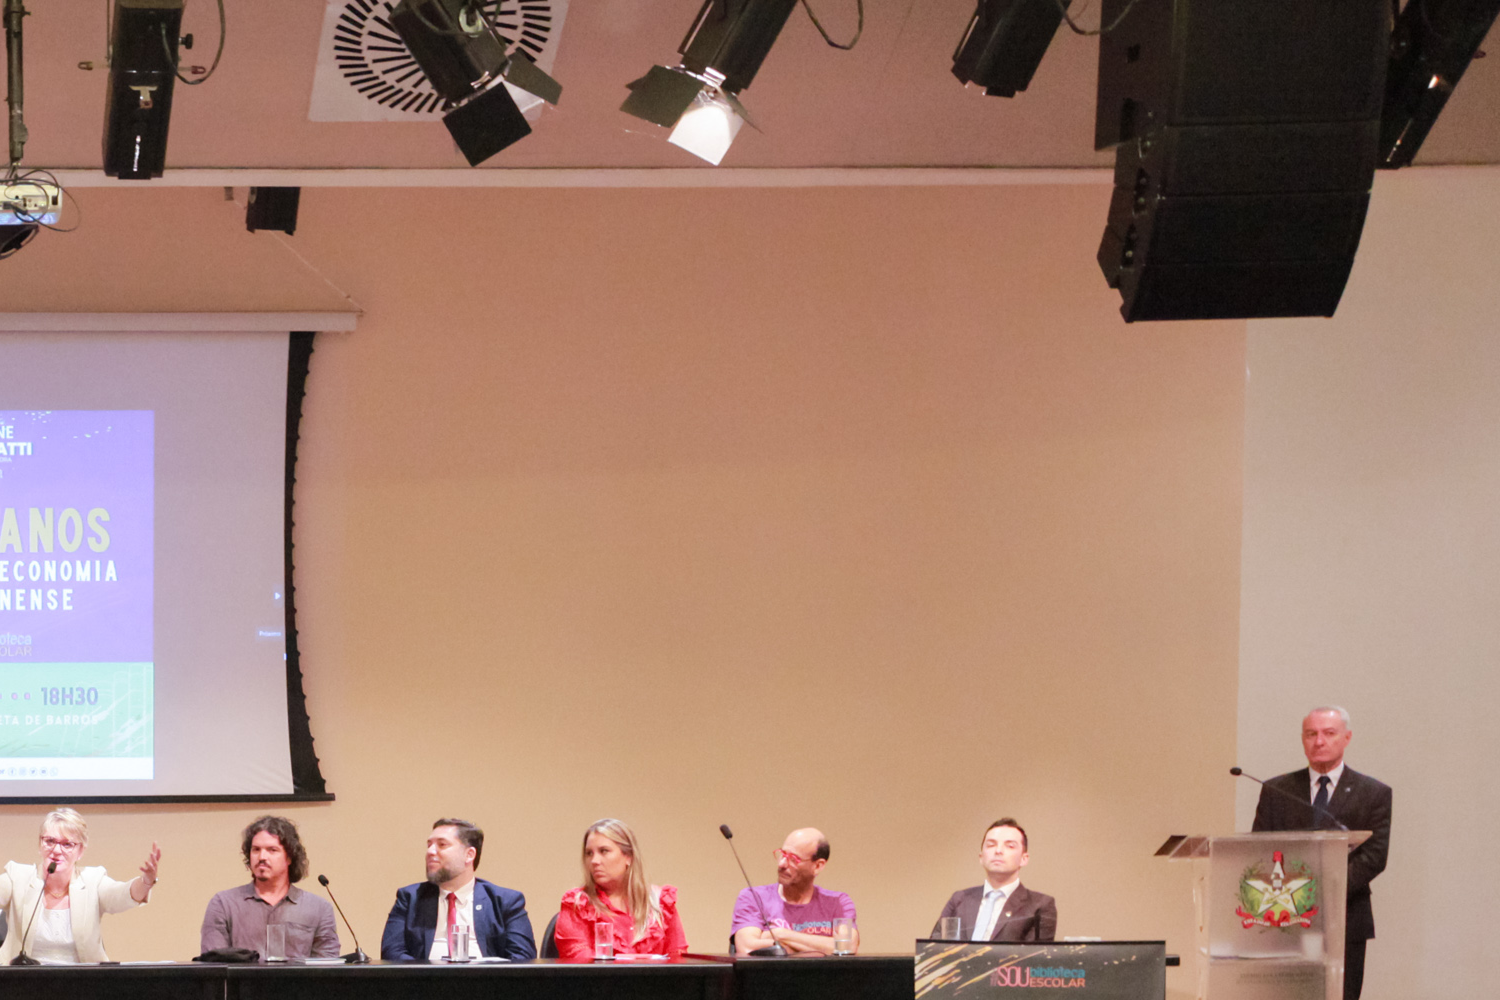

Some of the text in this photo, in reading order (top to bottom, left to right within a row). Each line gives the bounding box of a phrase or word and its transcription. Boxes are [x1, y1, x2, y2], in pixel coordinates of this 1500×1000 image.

[41, 686, 99, 706] 18H30
[25, 714, 41, 726] DE
[46, 713, 99, 726] BARROS
[1030, 966, 1085, 978] biblioteca
[1029, 978, 1086, 988] ESCOLAR
